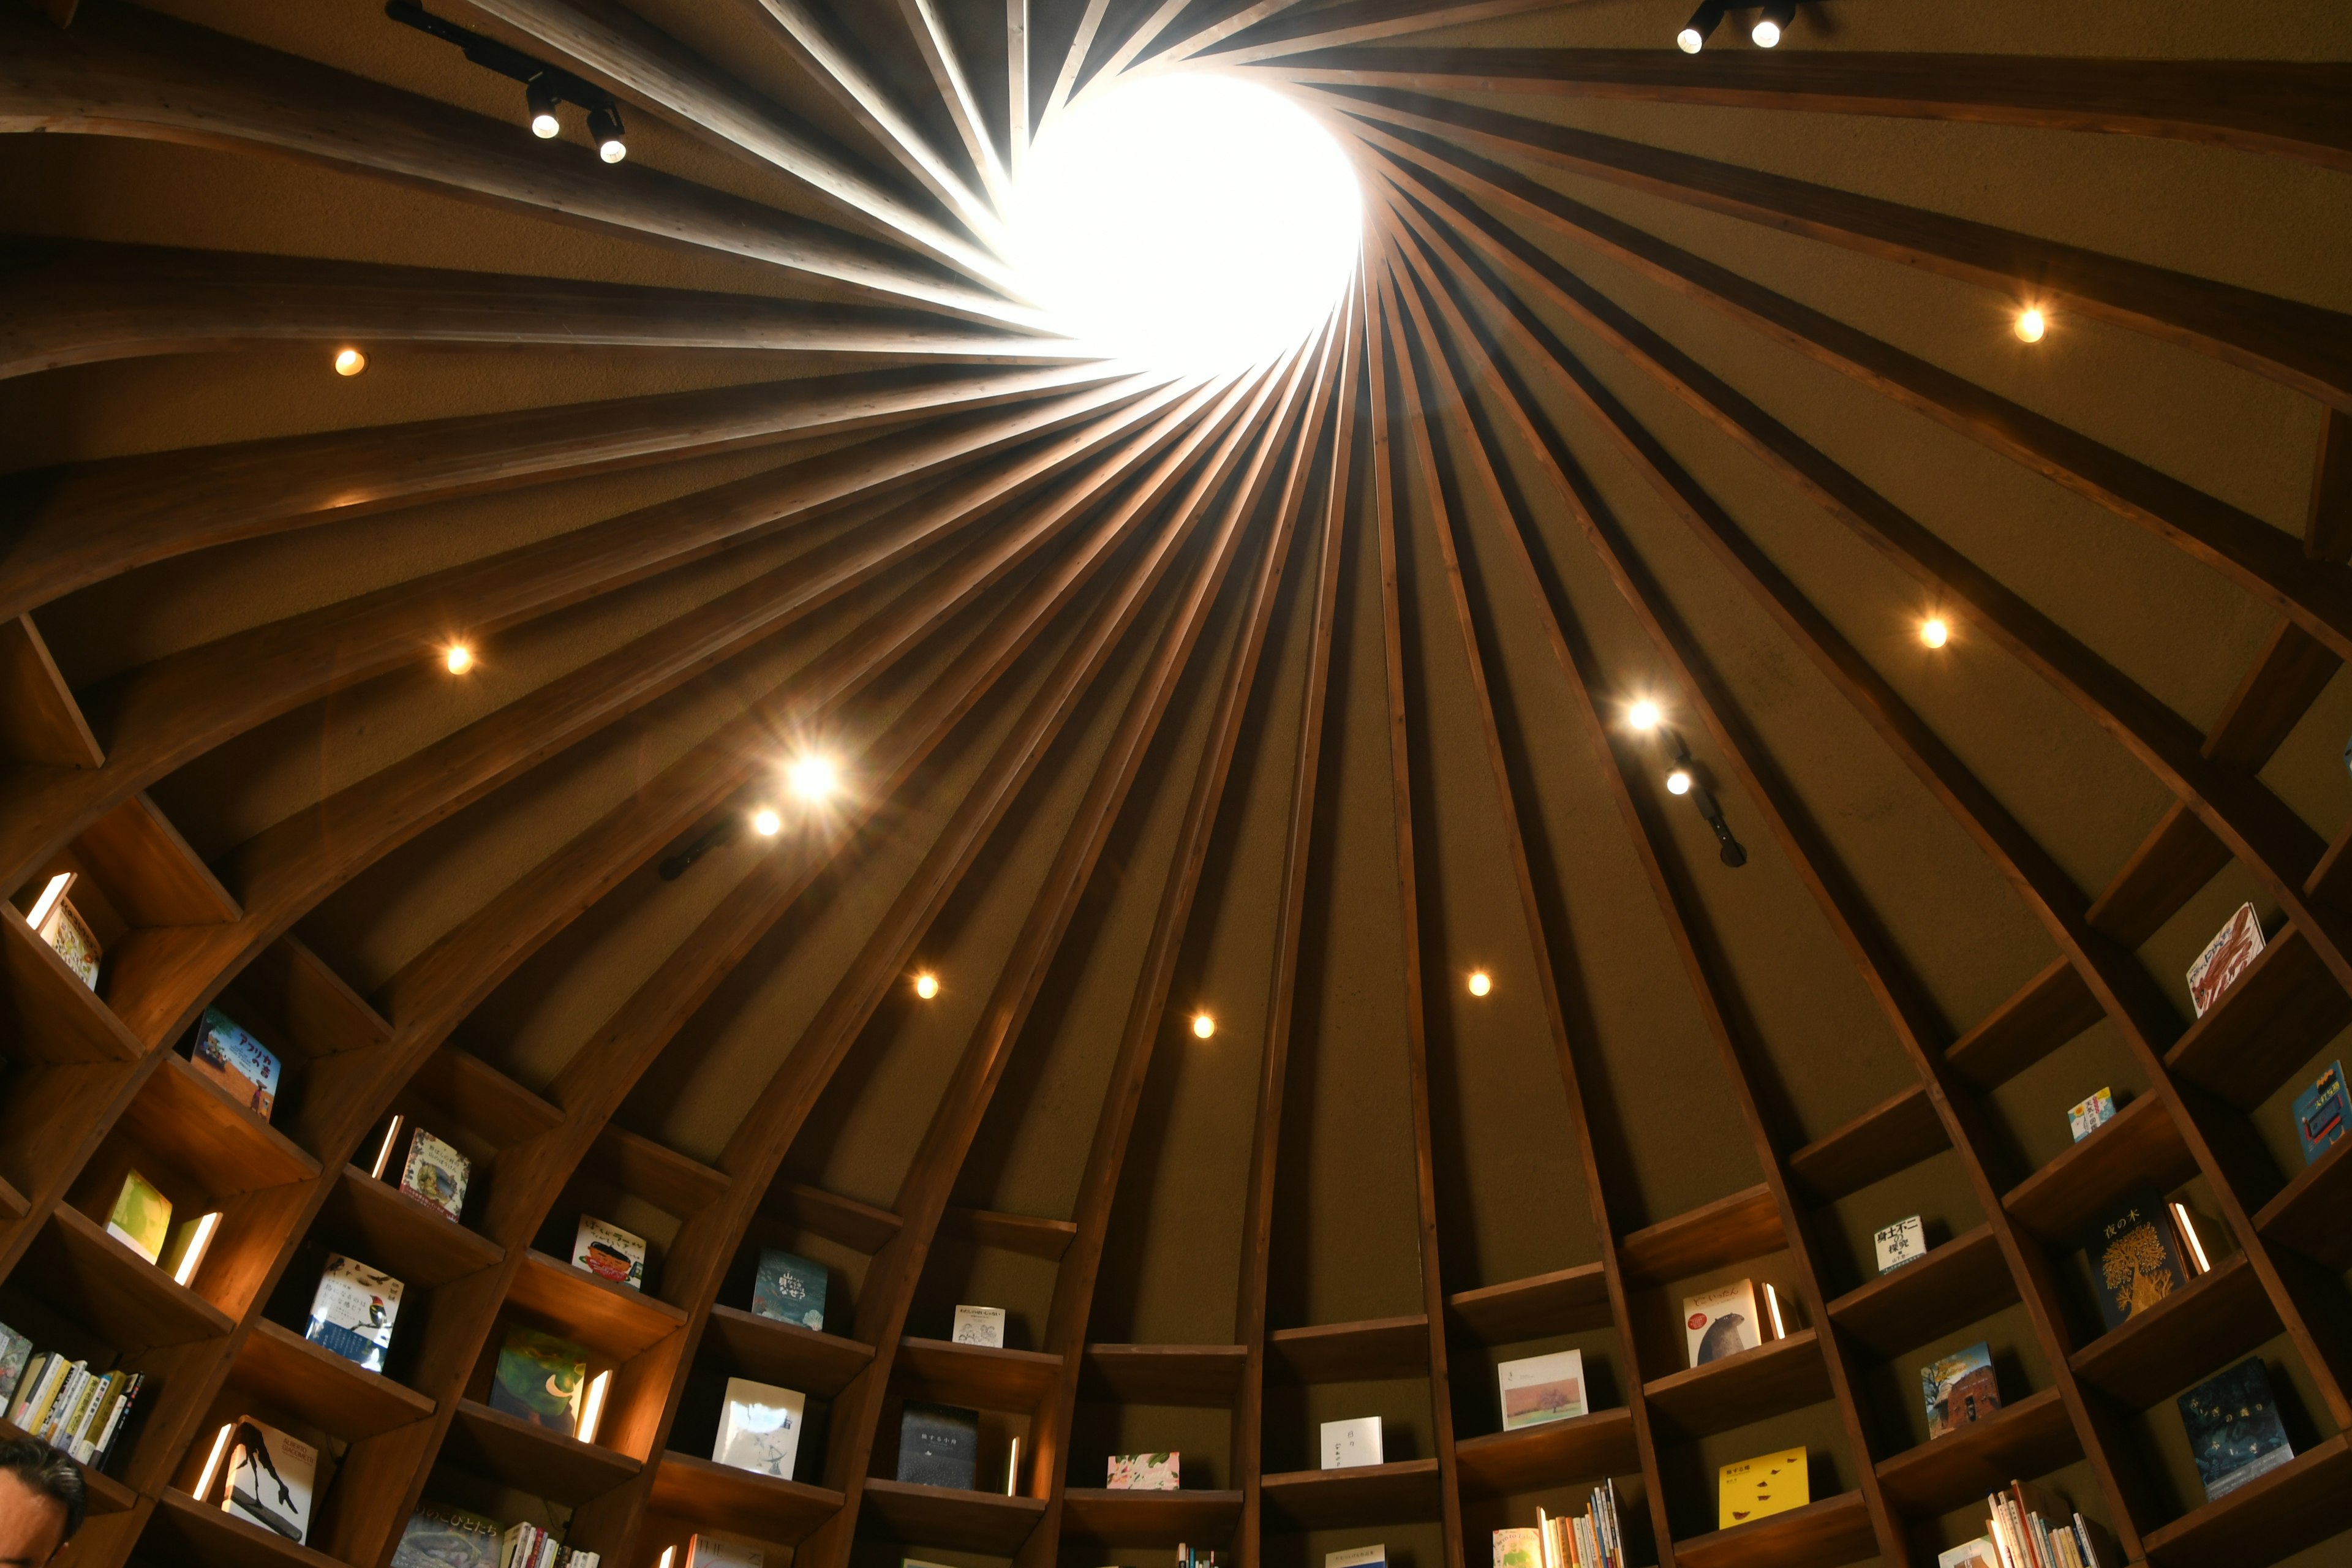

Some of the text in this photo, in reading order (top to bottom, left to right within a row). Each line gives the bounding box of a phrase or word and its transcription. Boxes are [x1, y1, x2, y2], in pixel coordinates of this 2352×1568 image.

[239, 1033, 271, 1065] アフリカ
[252, 1058, 271, 1079] の音
[1877, 1218, 1918, 1243] 身土不二
[2104, 1209, 2139, 1239] 夜の木
[1888, 1238, 1909, 1254] 探究
[1894, 1234, 1904, 1243] の
[325, 1283, 368, 1308] 鳥になるのは
[283, 1438, 307, 1453] ALBERTO
